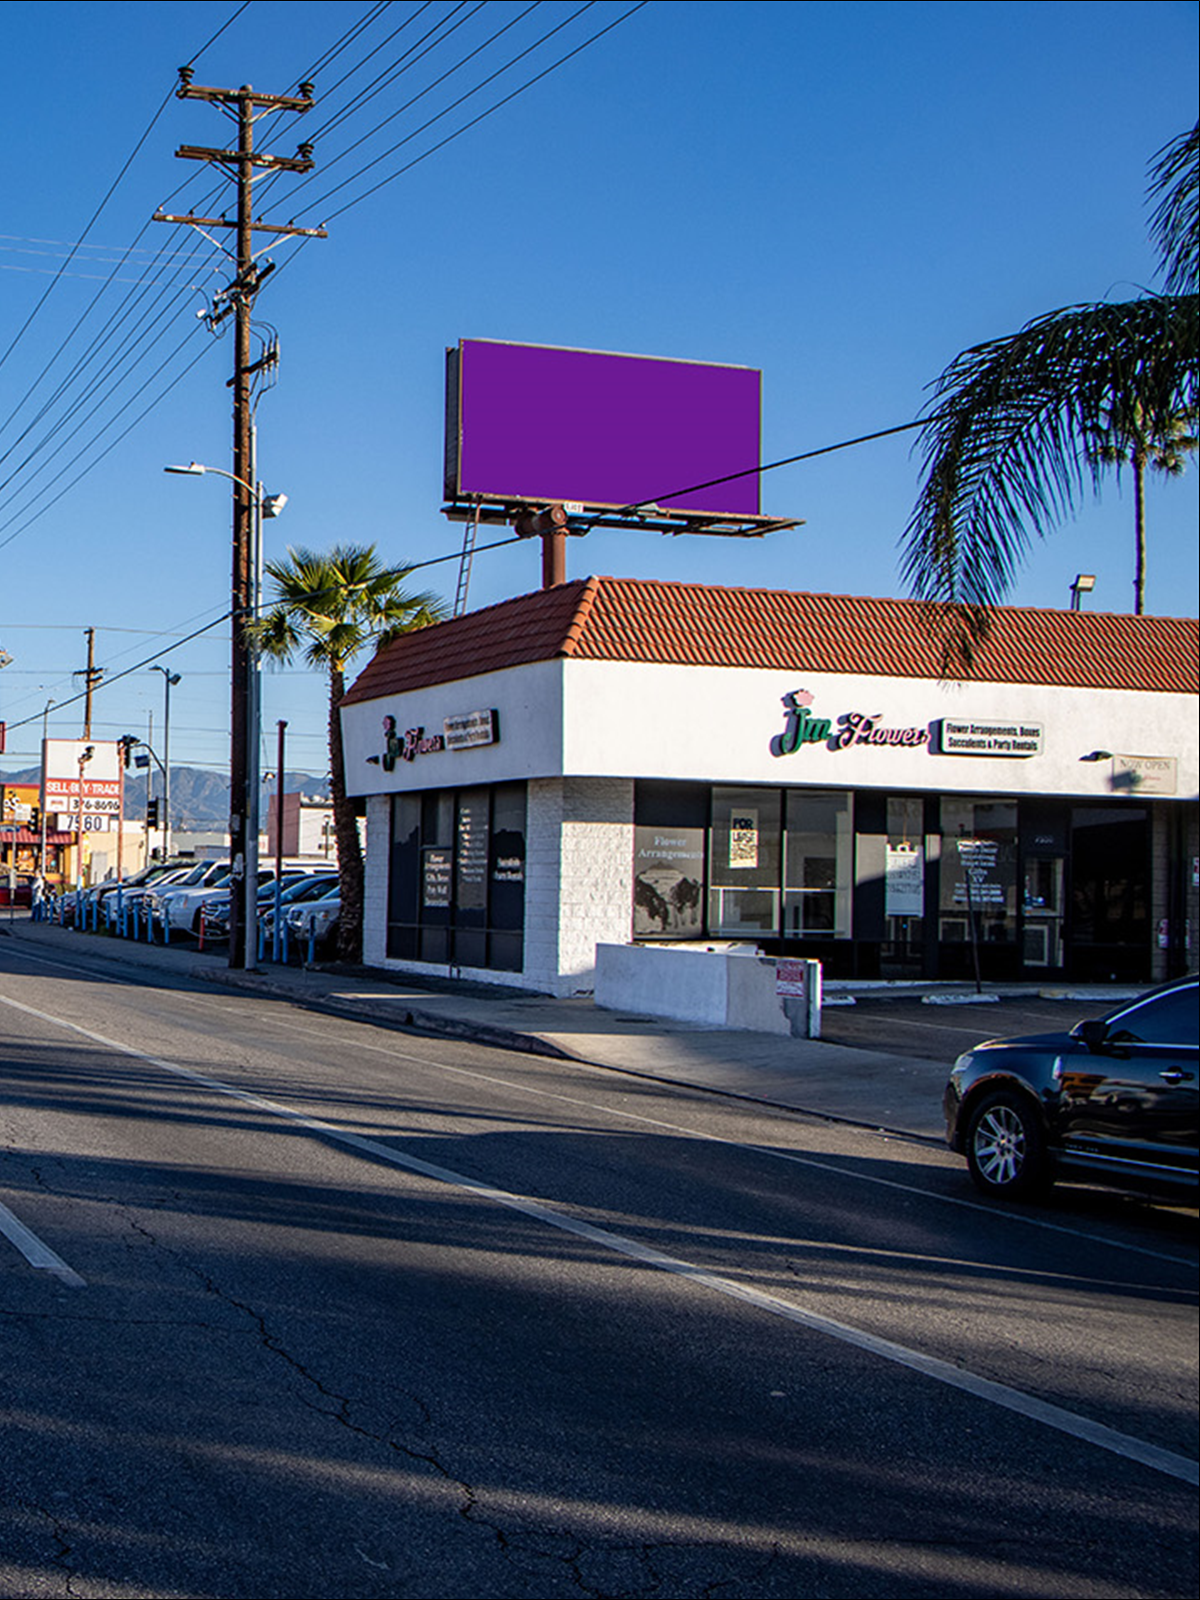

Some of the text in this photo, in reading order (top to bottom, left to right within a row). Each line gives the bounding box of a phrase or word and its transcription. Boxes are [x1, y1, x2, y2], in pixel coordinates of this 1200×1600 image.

[947, 723, 969, 734] Flower
[948, 736, 987, 749] Succulents
[993, 739, 1011, 751] Party
[1012, 740, 1039, 751] Rentals
[1144, 761, 1171, 770] OPEN
[733, 818, 754, 830] FOR
[654, 836, 687, 847] Flower
